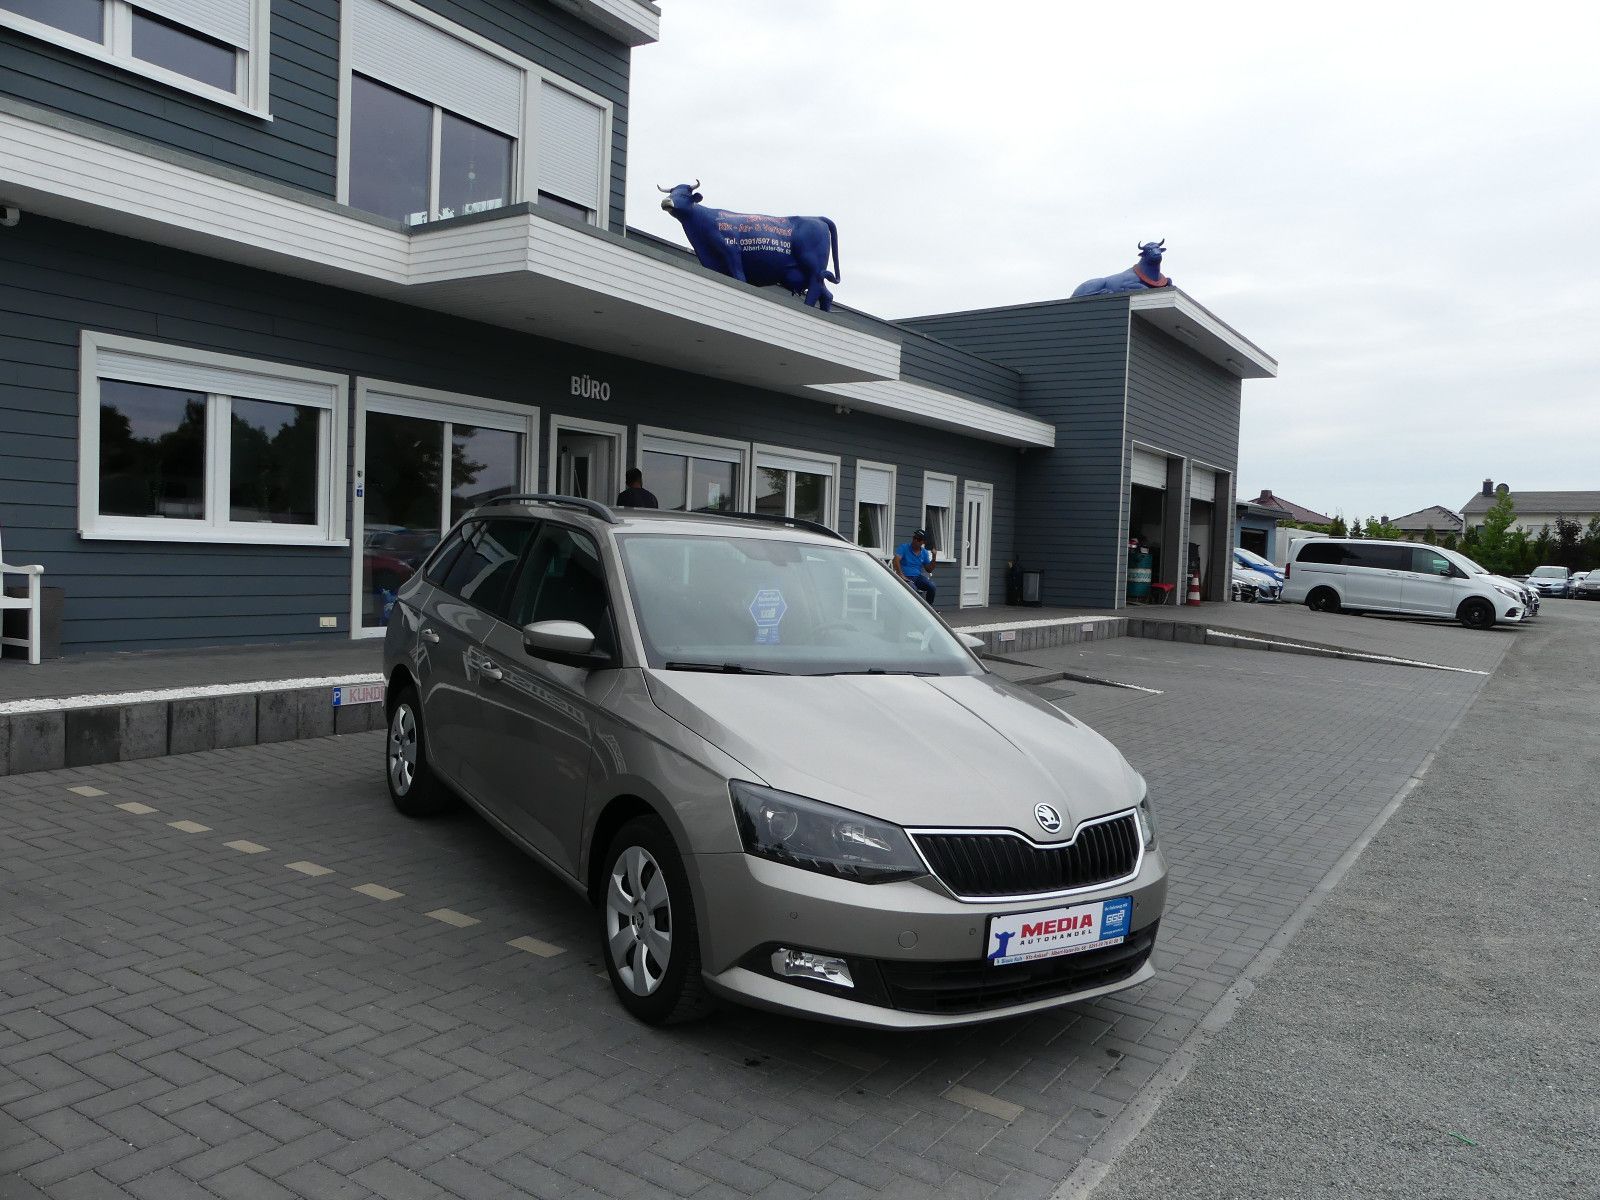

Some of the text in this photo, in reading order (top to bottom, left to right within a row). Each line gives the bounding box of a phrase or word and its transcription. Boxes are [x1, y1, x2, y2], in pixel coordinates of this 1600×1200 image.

[725, 237, 738, 245] Tel.
[571, 374, 611, 401] BÜRO
[334, 691, 341, 703] P
[1020, 914, 1093, 938] MEDIA
[1020, 930, 1093, 946] AUTOHANDEL
